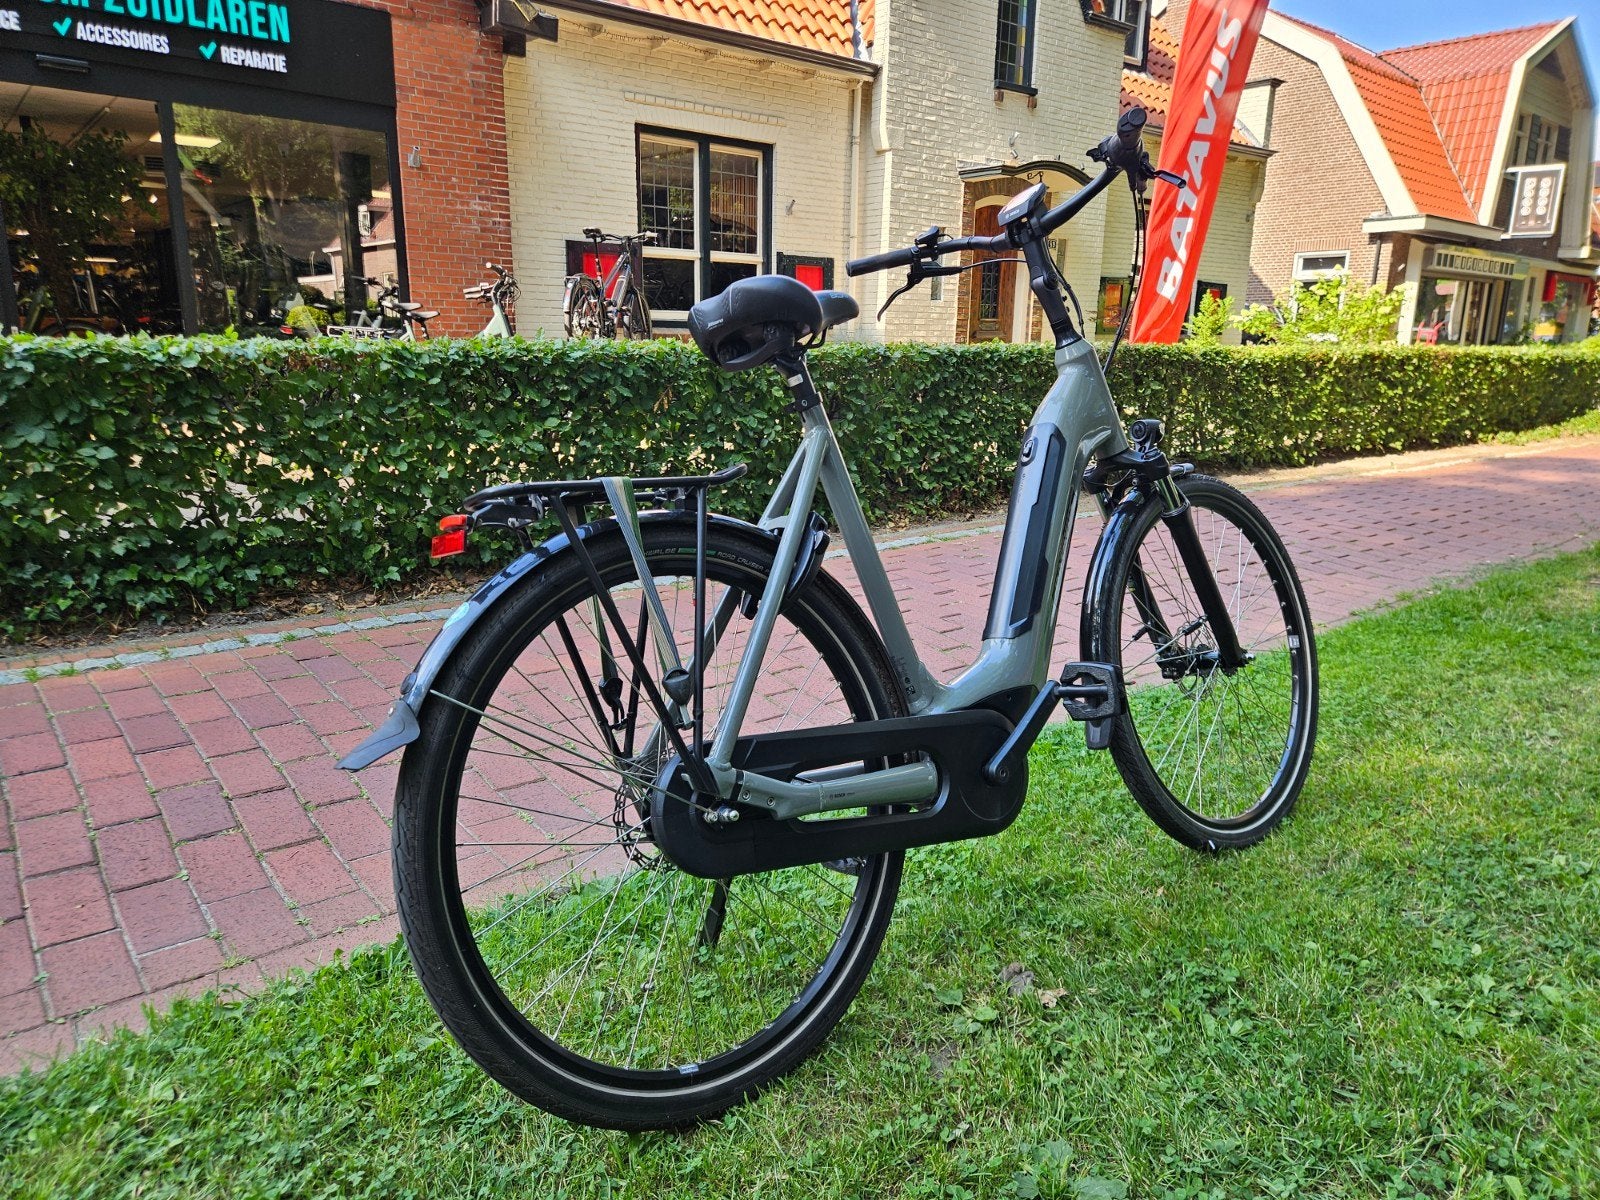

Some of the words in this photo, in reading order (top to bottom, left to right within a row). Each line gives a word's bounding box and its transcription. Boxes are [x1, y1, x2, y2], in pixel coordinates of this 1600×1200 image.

[76, 21, 170, 54] ACCESSOIRES
[220, 45, 288, 73] REPARATIE
[1156, 8, 1242, 304] BATAVUS
